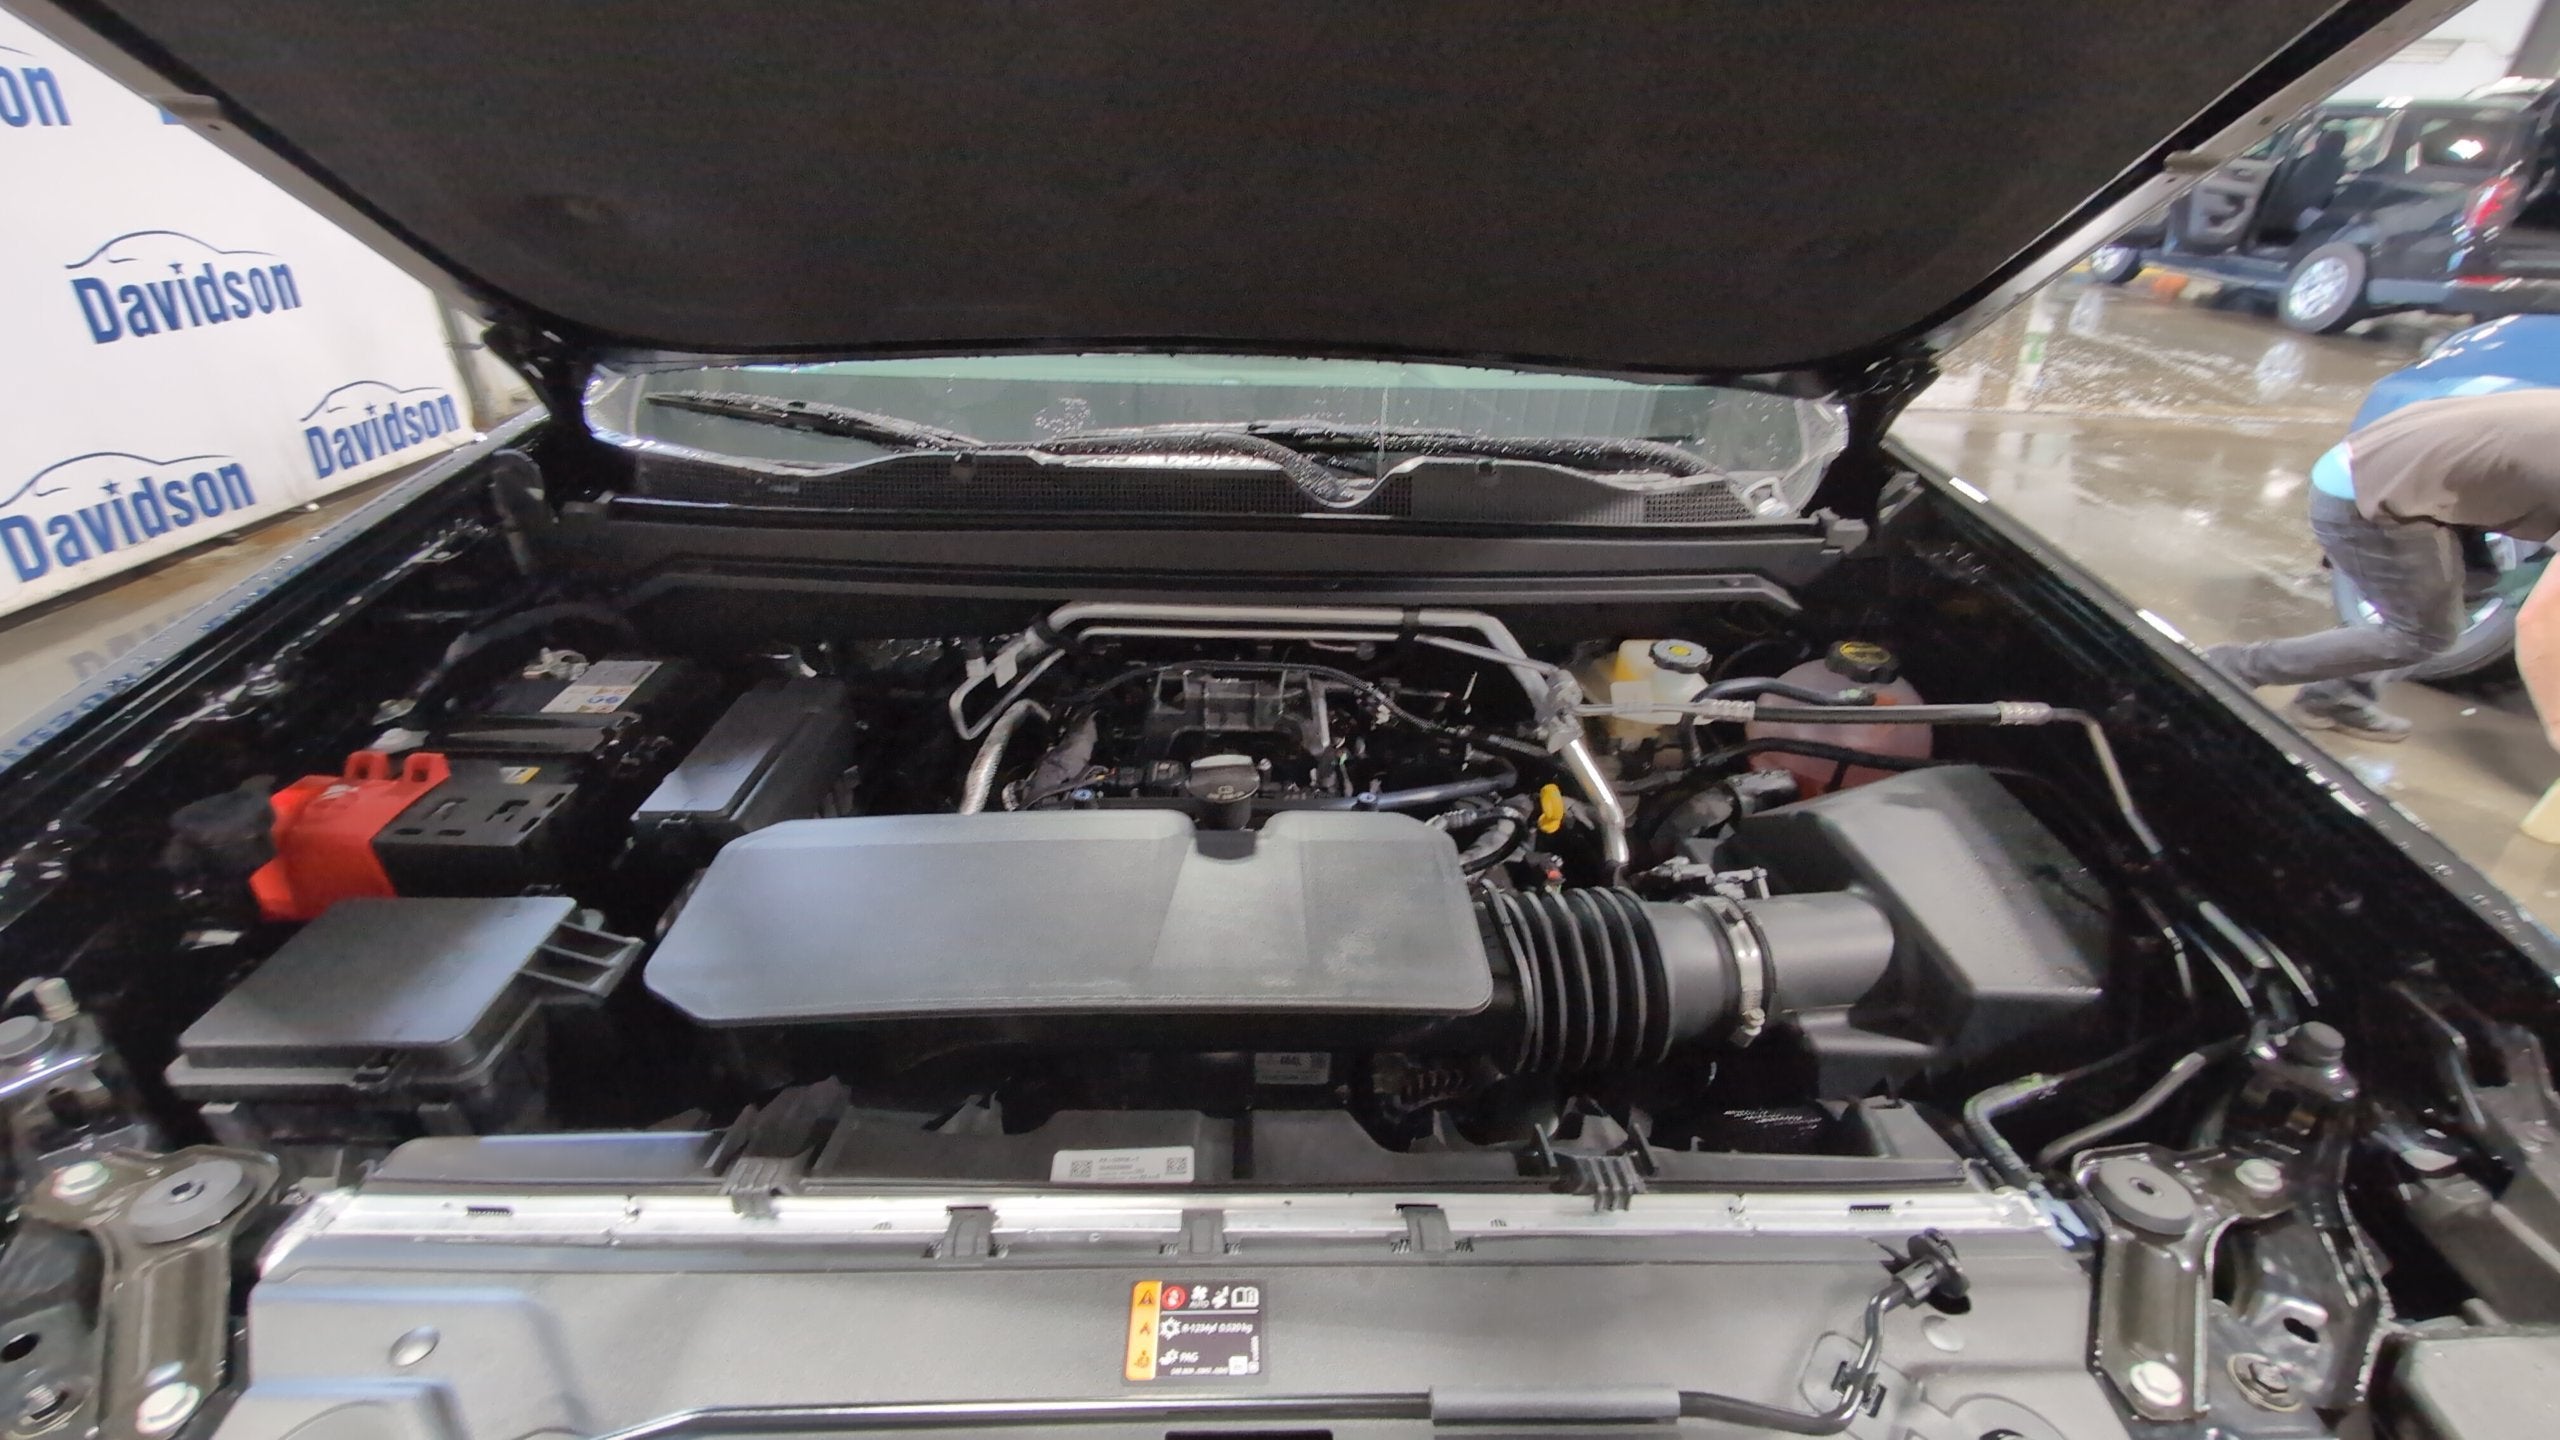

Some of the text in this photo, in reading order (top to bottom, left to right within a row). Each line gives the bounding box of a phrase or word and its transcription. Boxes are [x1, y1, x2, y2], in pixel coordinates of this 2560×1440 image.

[71, 262, 302, 344] Davidson
[304, 394, 459, 478] Davidson
[0, 461, 256, 583] Davidson
